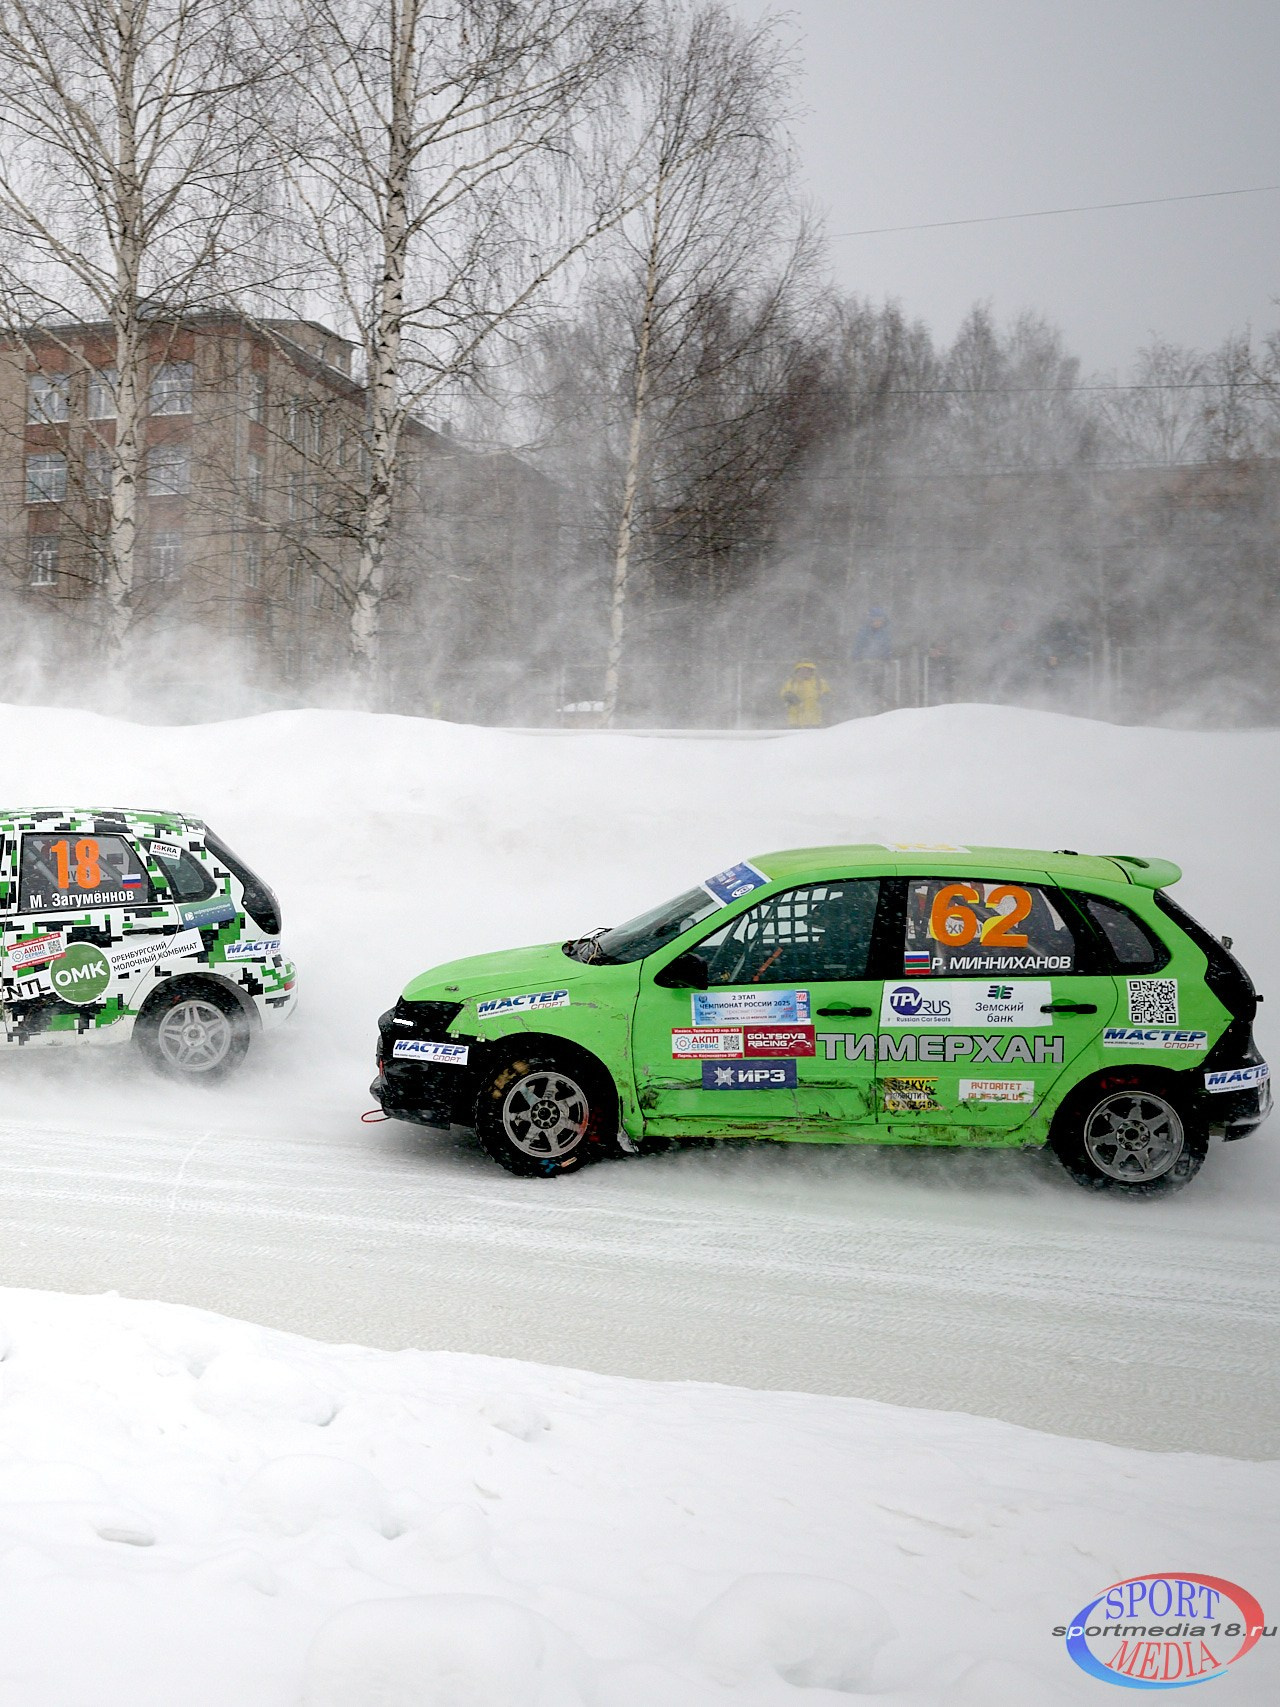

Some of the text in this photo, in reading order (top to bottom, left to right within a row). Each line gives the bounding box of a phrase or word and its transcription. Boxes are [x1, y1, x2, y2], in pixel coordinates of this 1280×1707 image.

[153, 844, 177, 854] ISKRA
[51, 839, 101, 889] 18
[29, 890, 135, 908] М. Загумённов
[930, 884, 1033, 948] 62
[24, 944, 45, 954] АКПП
[24, 950, 47, 959] СЕРВИС
[111, 941, 167, 964] ОРЕНБУРГСКИЙ
[112, 941, 199, 972] МОЛОЧНЫЙ КОМБИНАТ
[932, 956, 1072, 970] Р. МИННИХАНОВ
[55, 960, 107, 987] ОМК
[478, 989, 568, 1013] МАСТЕР
[530, 1001, 565, 1010] СПОРТ
[890, 992, 951, 1015] TPV RUS
[975, 1001, 1024, 1013] Земский
[987, 1012, 1014, 1023] банк
[747, 1032, 806, 1040] GOLTSOVA
[1104, 1028, 1207, 1042] МАСТЕР
[395, 1041, 467, 1056] МАСТЕР
[747, 1040, 788, 1048] RACING
[816, 1033, 1065, 1063] ТИМЕРХАН
[432, 1054, 462, 1062] СПОРТ
[738, 1069, 786, 1083] ИРЗ
[1208, 1064, 1269, 1085] МАСТЕ
